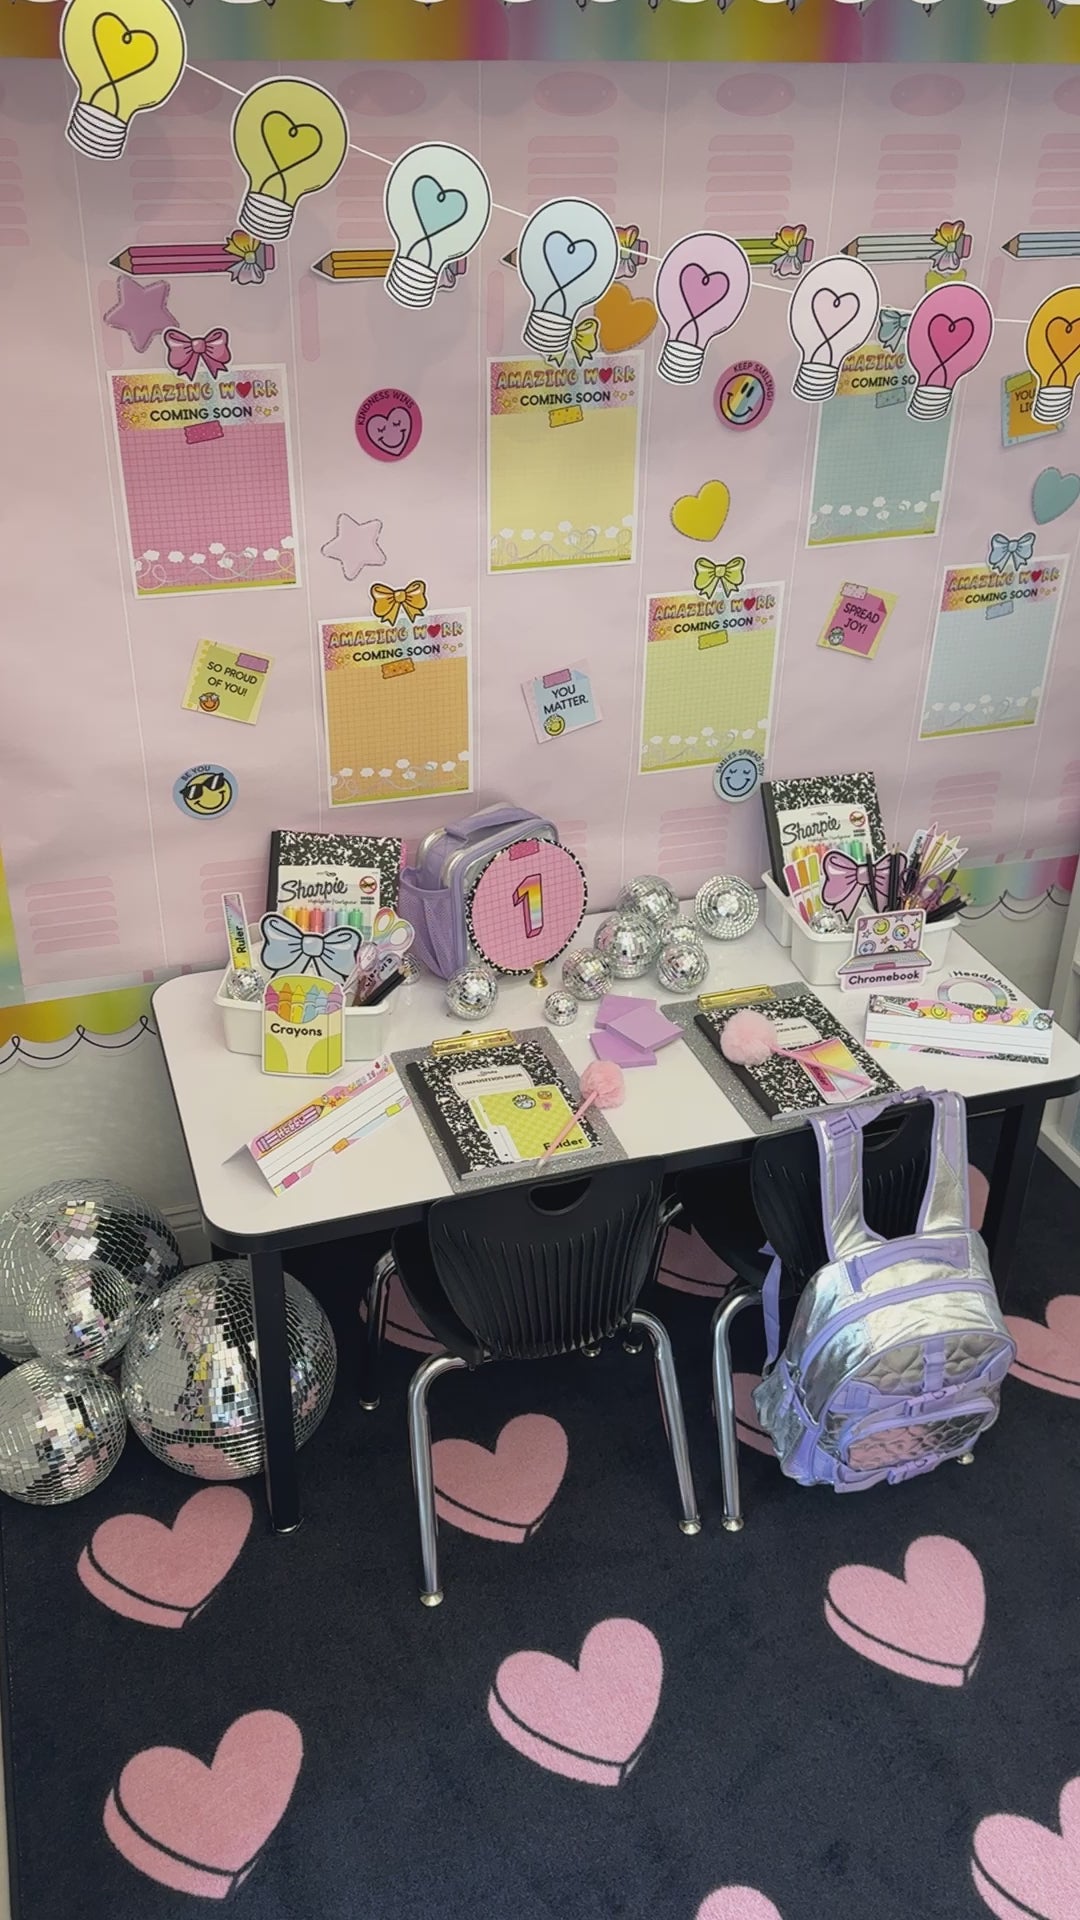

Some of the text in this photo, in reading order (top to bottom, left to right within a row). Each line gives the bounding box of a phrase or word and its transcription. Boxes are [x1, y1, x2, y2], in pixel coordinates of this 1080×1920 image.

[733, 362, 753, 373] KEEP
[842, 353, 905, 372] MAZING
[495, 368, 578, 390] AMAZING
[852, 374, 917, 389] COMING SO
[120, 382, 214, 404] AMAZING
[520, 391, 611, 407] COMING SOON
[150, 406, 252, 422] COMING SOON
[358, 391, 415, 426] KINDNESS WINS
[965, 588, 1038, 604] COMING SOON
[652, 599, 726, 621] AMAZING
[843, 602, 880, 624] SPREAD
[673, 617, 753, 633] COMING SOON
[843, 618, 868, 634] JOY!
[328, 627, 408, 648] AMAZING
[353, 644, 440, 662] COMING SOON
[207, 661, 258, 685] SO PROUD
[207, 677, 248, 696] OF YOU!
[551, 684, 576, 698] YOU
[543, 694, 589, 715] MATTER.
[738, 749, 762, 762] SPREAD
[181, 765, 211, 781] BE YOU
[782, 816, 841, 846] Sharpie
[277, 877, 348, 903] Sharpie
[512, 873, 544, 938] 1
[235, 925, 247, 953] Ruler
[848, 970, 920, 985] Chromebook
[953, 970, 1018, 1001] Headphones
[270, 1023, 322, 1038] Crayons
[543, 1139, 584, 1151] Flder
